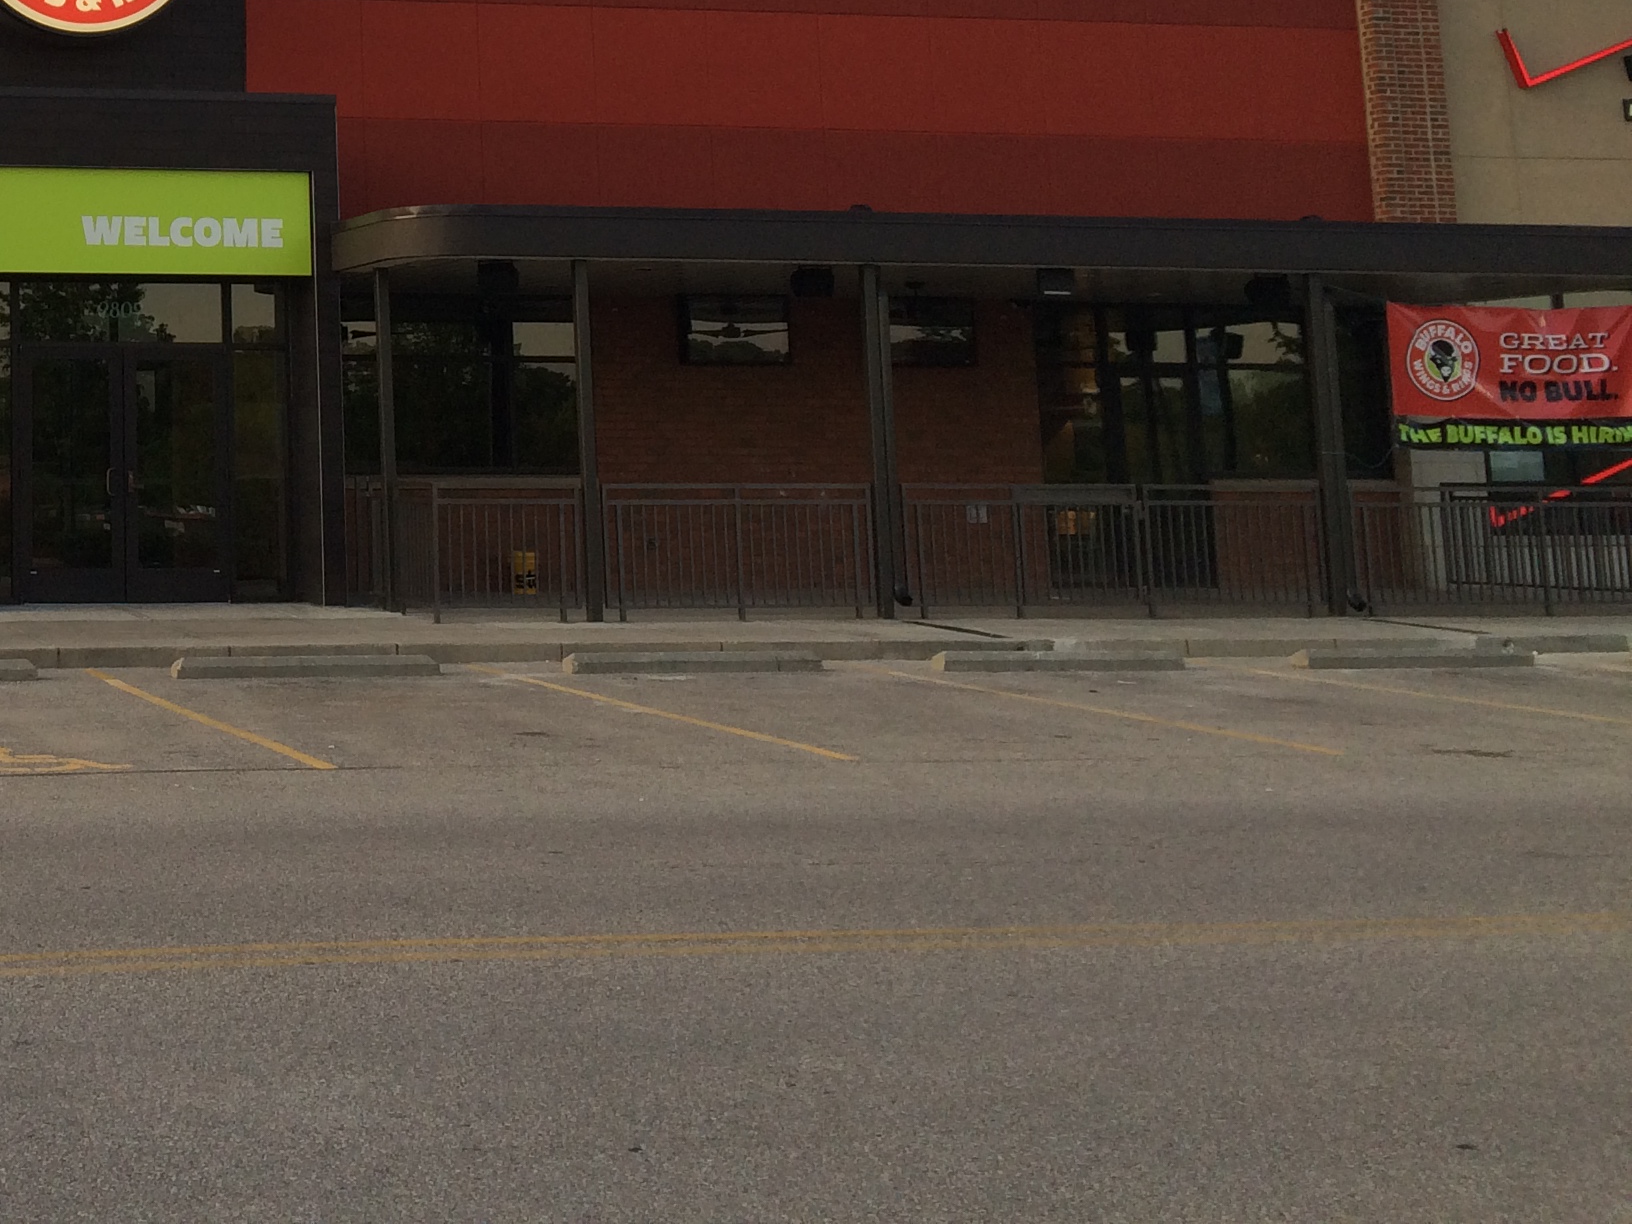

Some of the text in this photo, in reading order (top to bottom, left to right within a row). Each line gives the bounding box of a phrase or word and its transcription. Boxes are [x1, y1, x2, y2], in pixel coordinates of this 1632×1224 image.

[81, 215, 283, 248] WELCOME
[1415, 325, 1472, 354] BUFFALO
[1499, 332, 1608, 350] GREAT
[1499, 353, 1618, 374] FOOD.
[1413, 359, 1441, 393] WINGS
[1442, 384, 1450, 394] &
[1499, 379, 1618, 402] NO BULL.
[1400, 424, 1442, 444] THE
[1446, 425, 1543, 444] BUFFALO
[1546, 426, 1567, 444] IS
